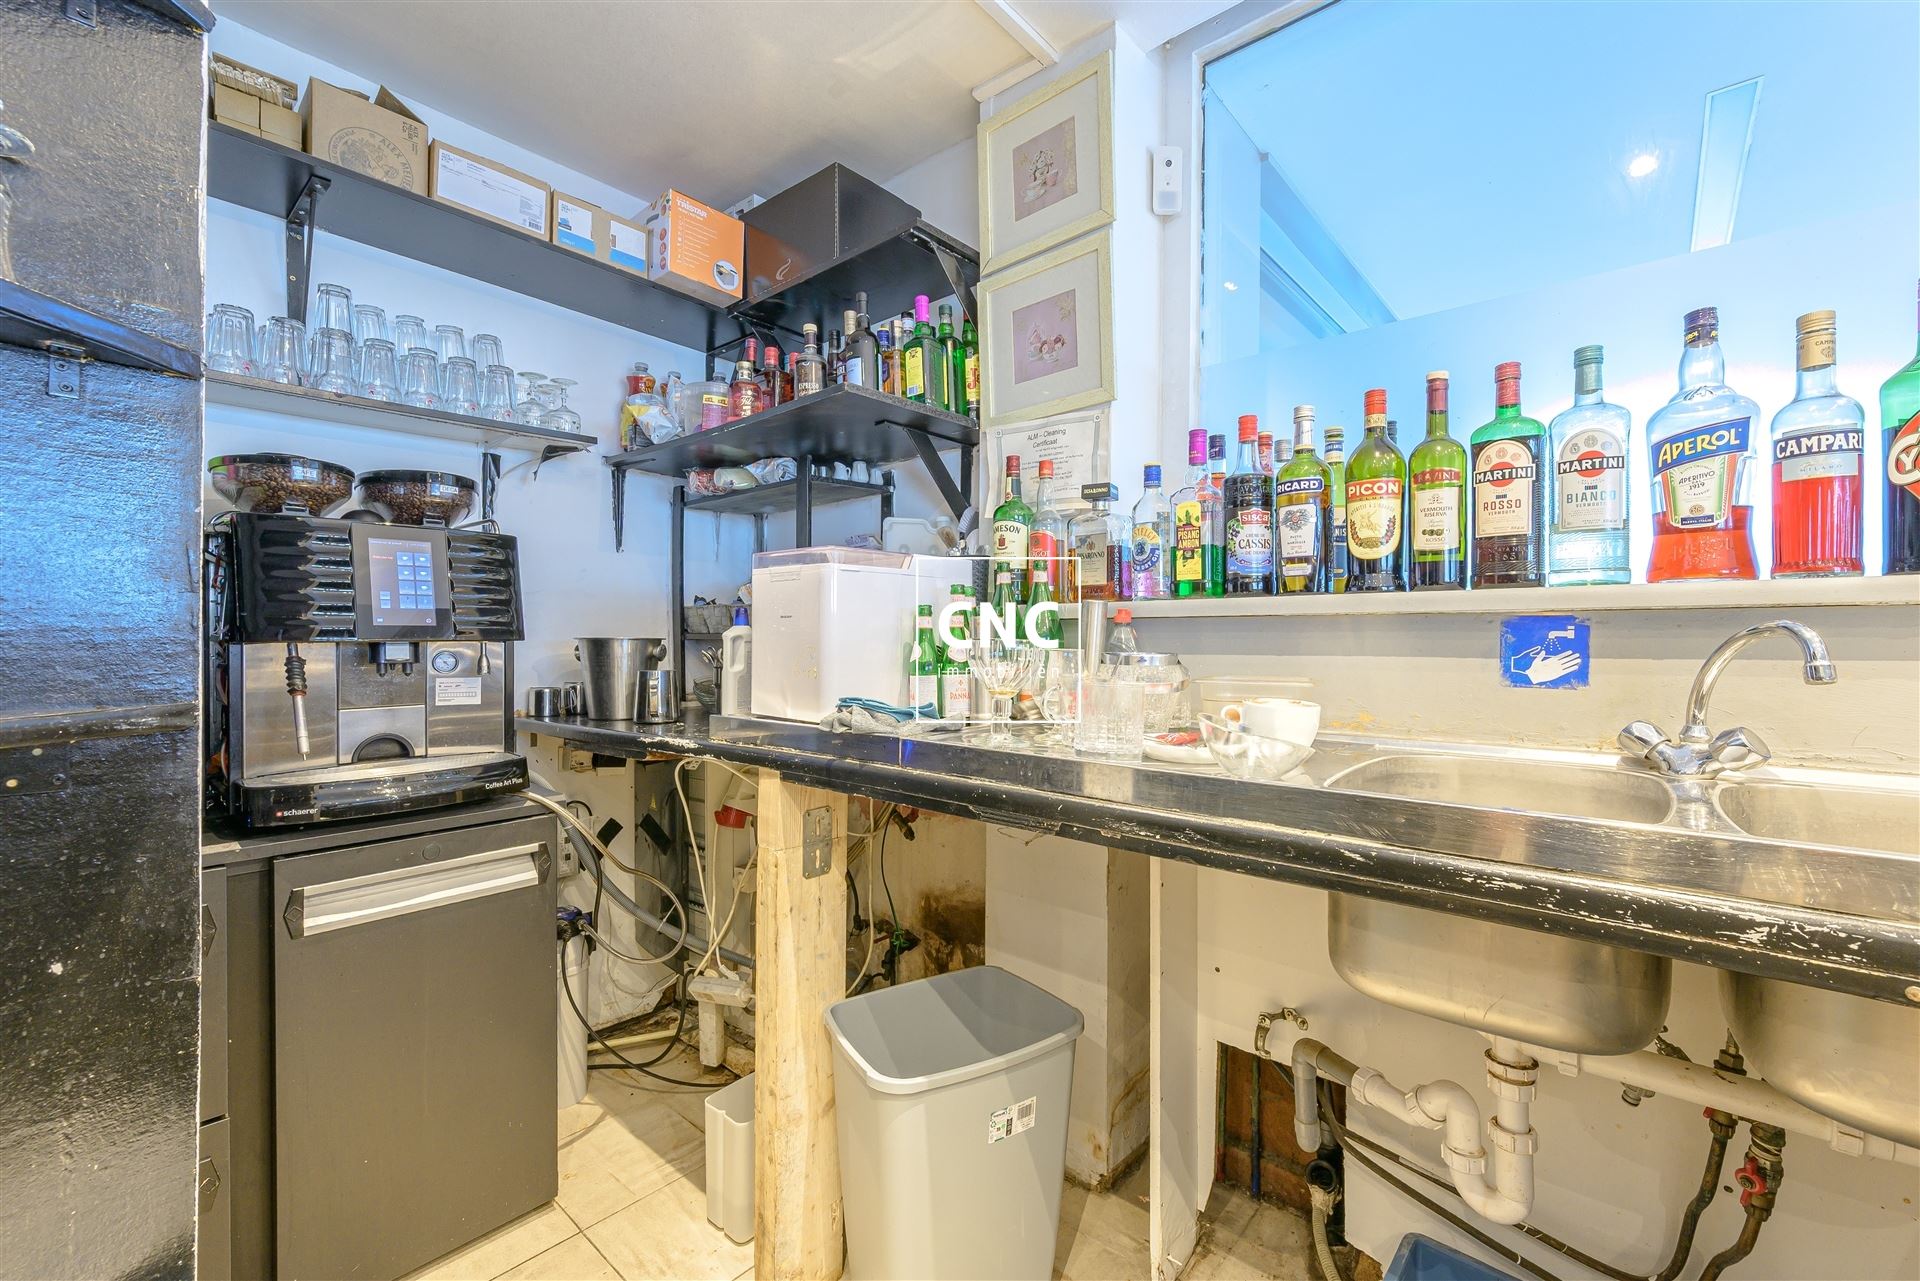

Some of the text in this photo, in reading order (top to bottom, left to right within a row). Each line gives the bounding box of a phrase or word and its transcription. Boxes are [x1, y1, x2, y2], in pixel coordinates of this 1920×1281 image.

[1027, 433, 1038, 441] ALM
[1043, 428, 1067, 438] Cleaning
[1032, 438, 1058, 449] Certificaat
[1658, 428, 1740, 468] APEROL
[1776, 433, 1862, 458] CAMPARI
[1559, 457, 1623, 473] MARTINI
[1888, 433, 1920, 485] CY
[1476, 467, 1531, 483] MARTINI
[1679, 470, 1715, 485] APERITIVO
[1277, 480, 1319, 493] RICARD
[1348, 482, 1399, 498] PICON
[1689, 482, 1705, 490] 1919
[1566, 490, 1616, 504] BIANCO
[1483, 499, 1521, 511] ROSSO
[1177, 530, 1200, 540] PISANG
[1177, 540, 1200, 549] AMBON
[1238, 538, 1271, 549] CASSIS
[485, 781, 503, 790] Coffee
[283, 808, 319, 817] schaerer
